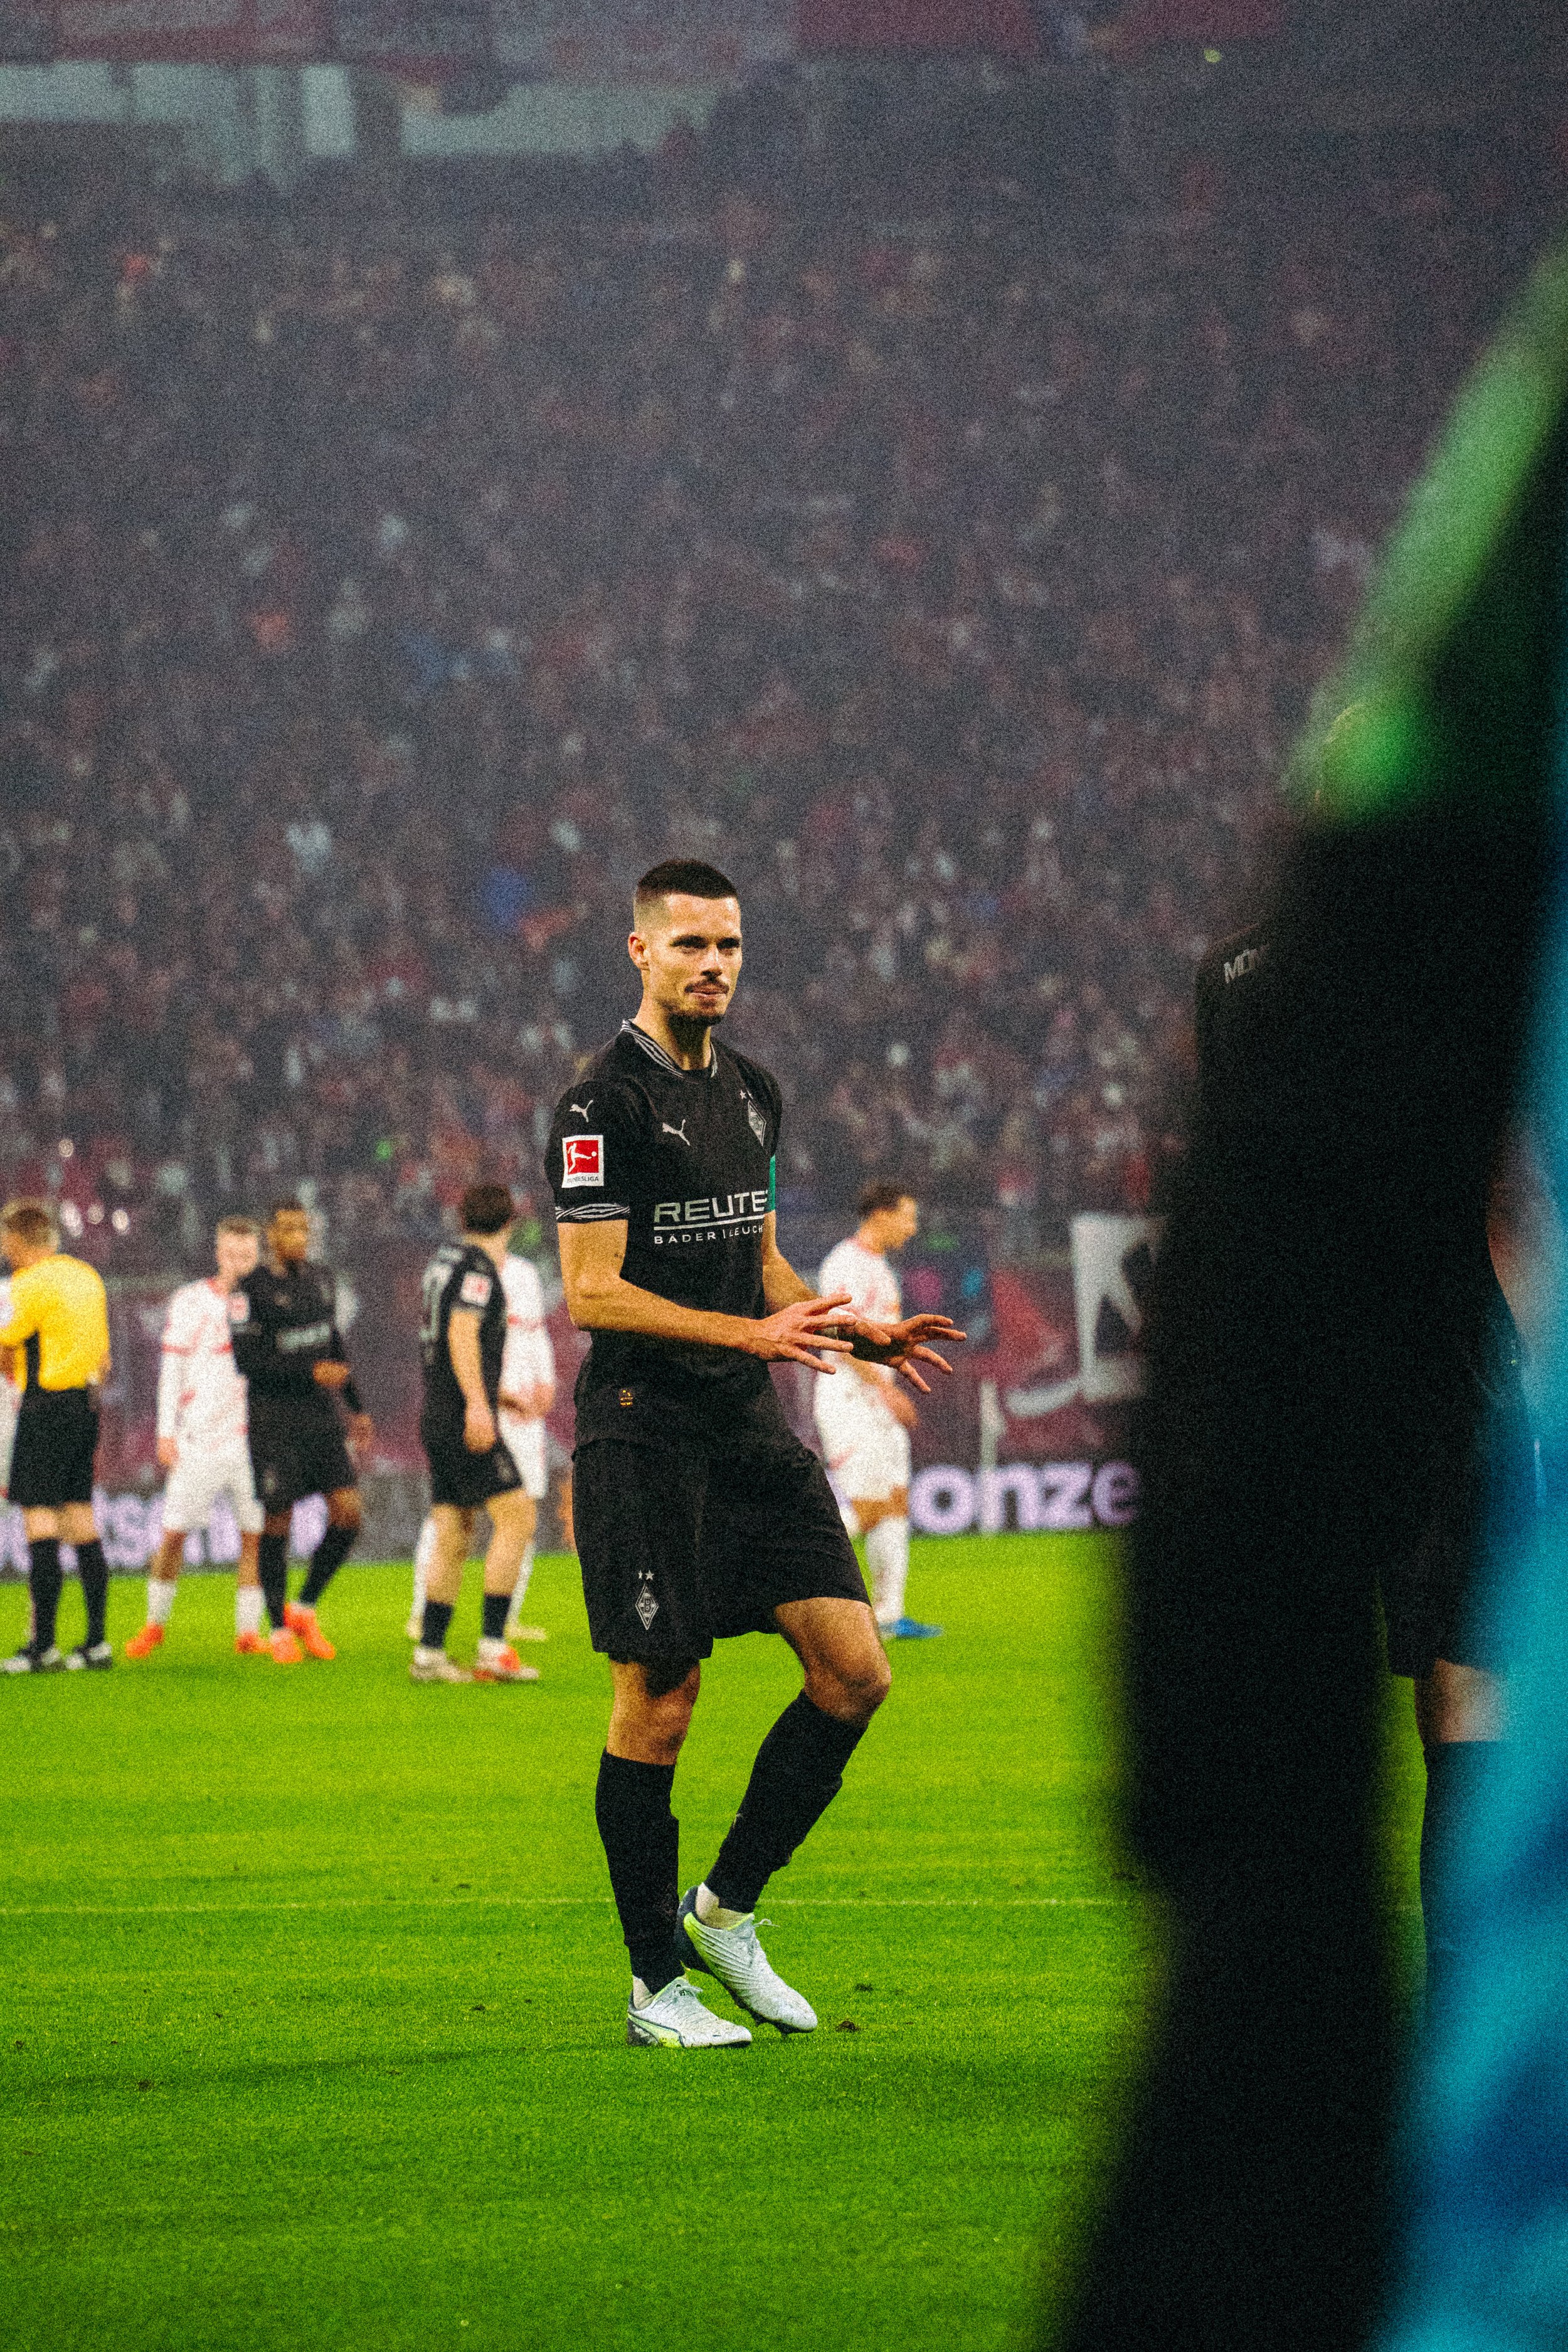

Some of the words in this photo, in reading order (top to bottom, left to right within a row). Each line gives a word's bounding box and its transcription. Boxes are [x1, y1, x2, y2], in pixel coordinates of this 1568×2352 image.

[654, 1190, 768, 1222] REUTE
[654, 1231, 716, 1244] BÄDER
[729, 1224, 764, 1237] LEUCH
